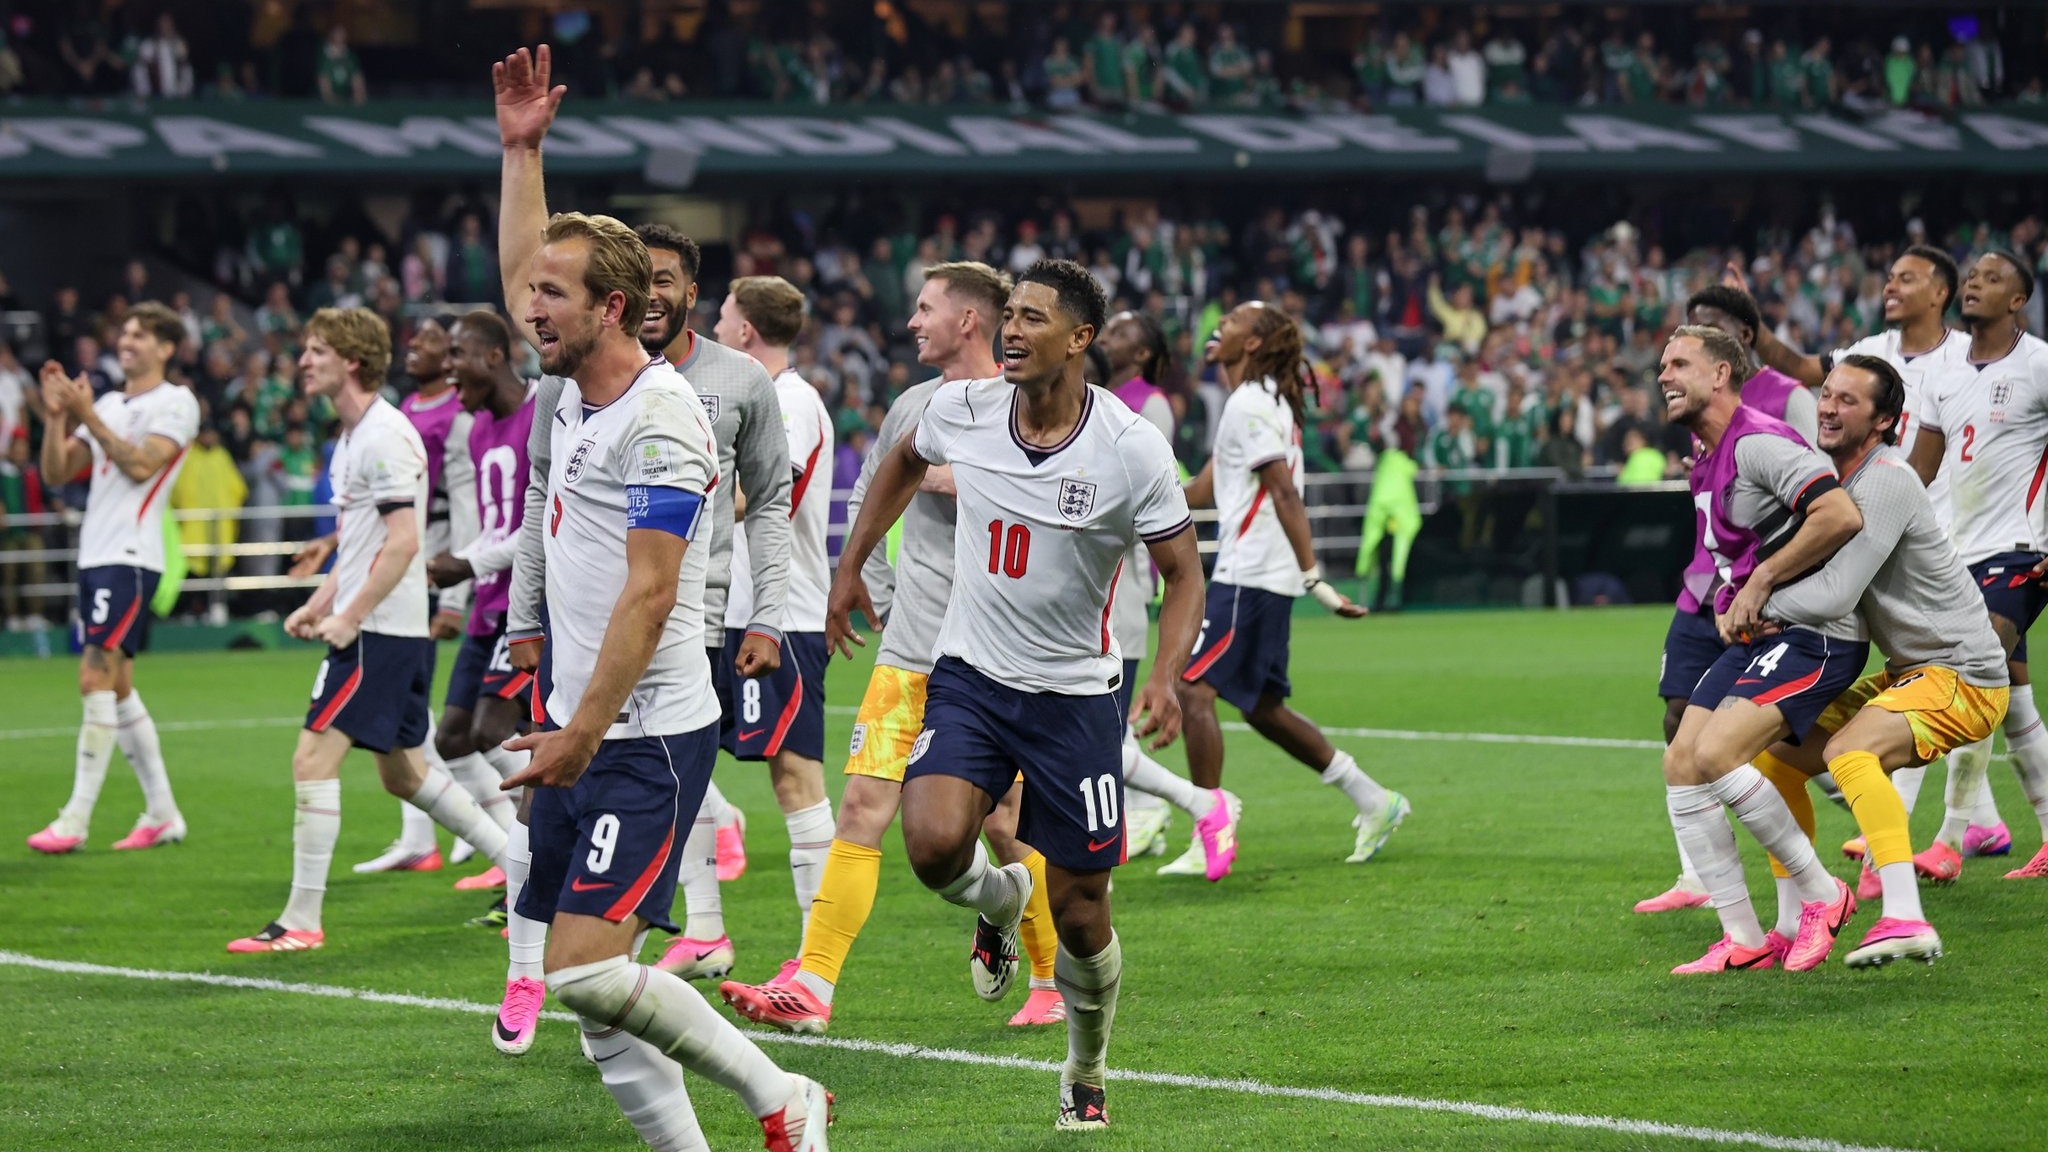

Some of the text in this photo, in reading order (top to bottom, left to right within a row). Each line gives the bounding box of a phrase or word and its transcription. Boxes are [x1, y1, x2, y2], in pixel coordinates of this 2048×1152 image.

[0, 117, 325, 158] PA
[303, 115, 1197, 157] MONDIAL
[1182, 114, 1461, 152] DE
[1440, 114, 1722, 153] LA
[1961, 424, 1975, 462] 2
[642, 466, 668, 476] EDUCATION
[988, 519, 1031, 579] 10
[92, 588, 112, 625] 5
[743, 678, 761, 723] 8
[1079, 773, 1118, 831] 10
[586, 813, 620, 874] 9
